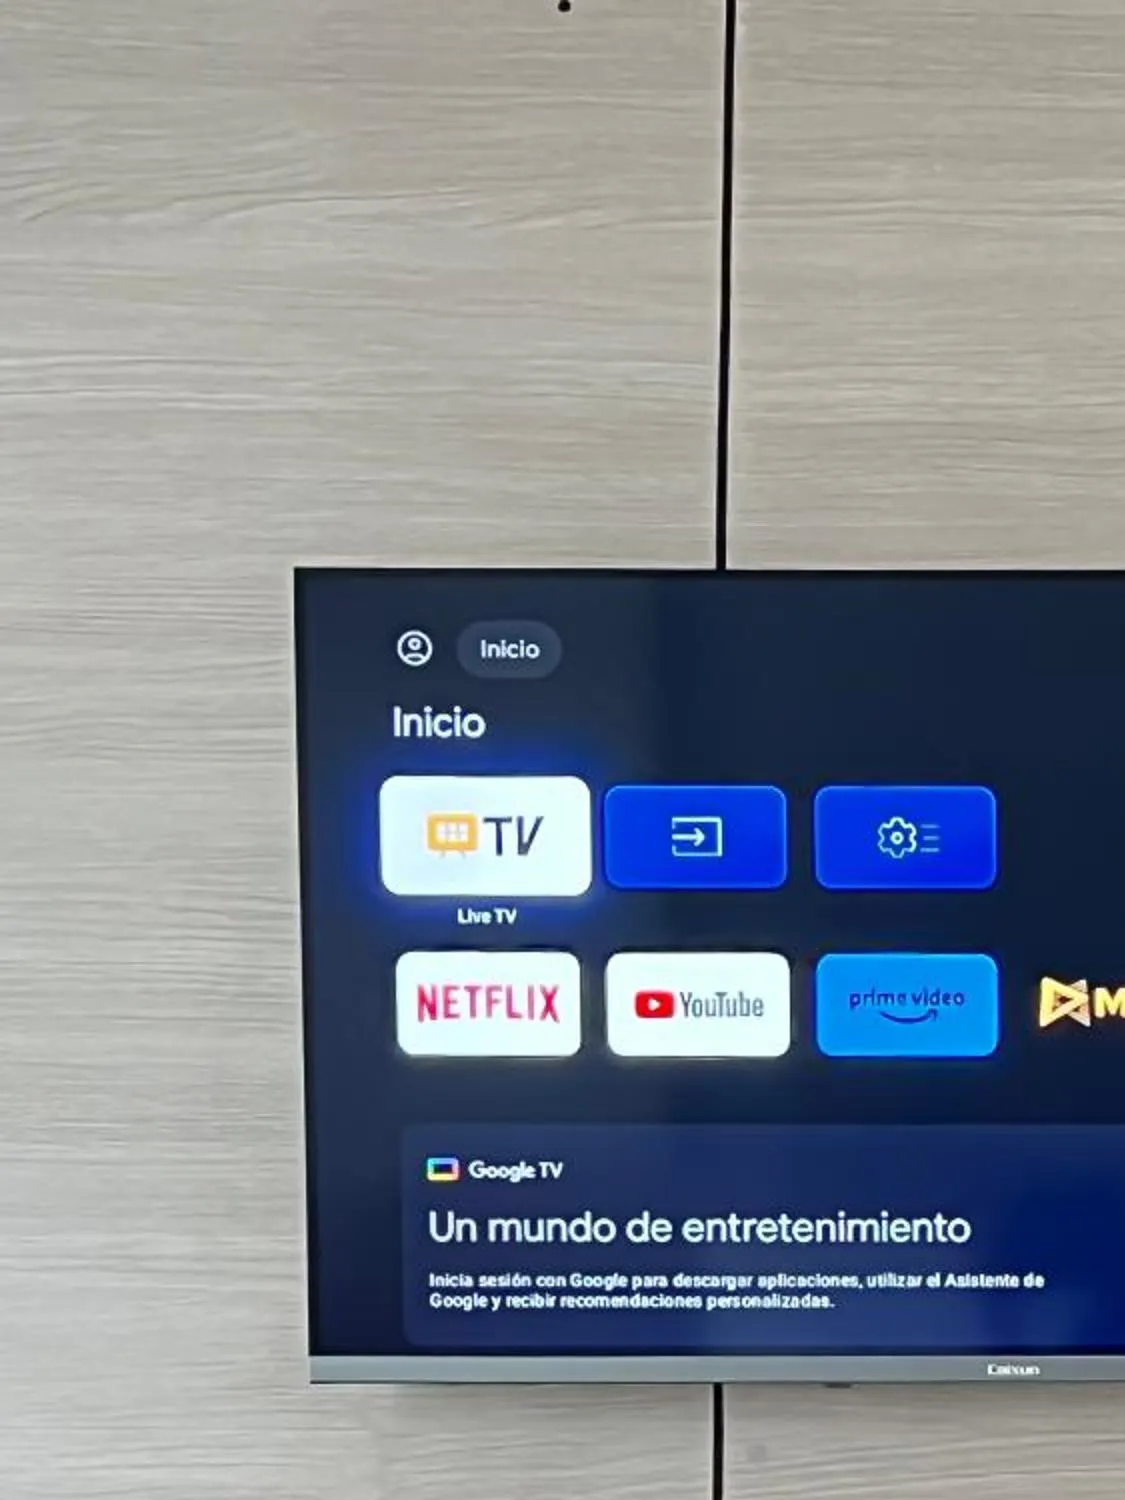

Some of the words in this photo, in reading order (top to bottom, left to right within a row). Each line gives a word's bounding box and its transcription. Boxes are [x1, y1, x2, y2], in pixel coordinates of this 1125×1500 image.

[480, 638, 541, 660] Inicio
[392, 705, 487, 739] Inicio
[483, 815, 544, 856] TV
[456, 908, 492, 925] Live
[493, 908, 518, 925] TV
[416, 984, 559, 1022] NETFLIX
[679, 990, 765, 1019] YouTube
[848, 988, 906, 1011] prime
[909, 987, 966, 1008] video
[467, 1159, 537, 1183] Google
[539, 1159, 564, 1178] TV
[428, 1210, 478, 1243] Un
[488, 1210, 617, 1243] mundo
[625, 1210, 673, 1243] de
[681, 1209, 972, 1244] entretenimiento
[429, 1272, 474, 1288] Inicia
[478, 1272, 532, 1288] sesión
[535, 1274, 567, 1288] con
[569, 1272, 629, 1291] Google
[631, 1275, 669, 1291] para
[672, 1272, 754, 1291] descargar
[757, 1272, 864, 1291] aplicaciones,
[866, 1271, 923, 1288] utilizar
[925, 1271, 941, 1288] el
[943, 1272, 1020, 1288] Asistente
[1023, 1271, 1046, 1288] de
[429, 1293, 489, 1312] Google
[491, 1295, 502, 1312] y
[505, 1292, 557, 1309] recibir
[559, 1292, 703, 1309] recomendaciones
[706, 1292, 836, 1311] personalizadas.
